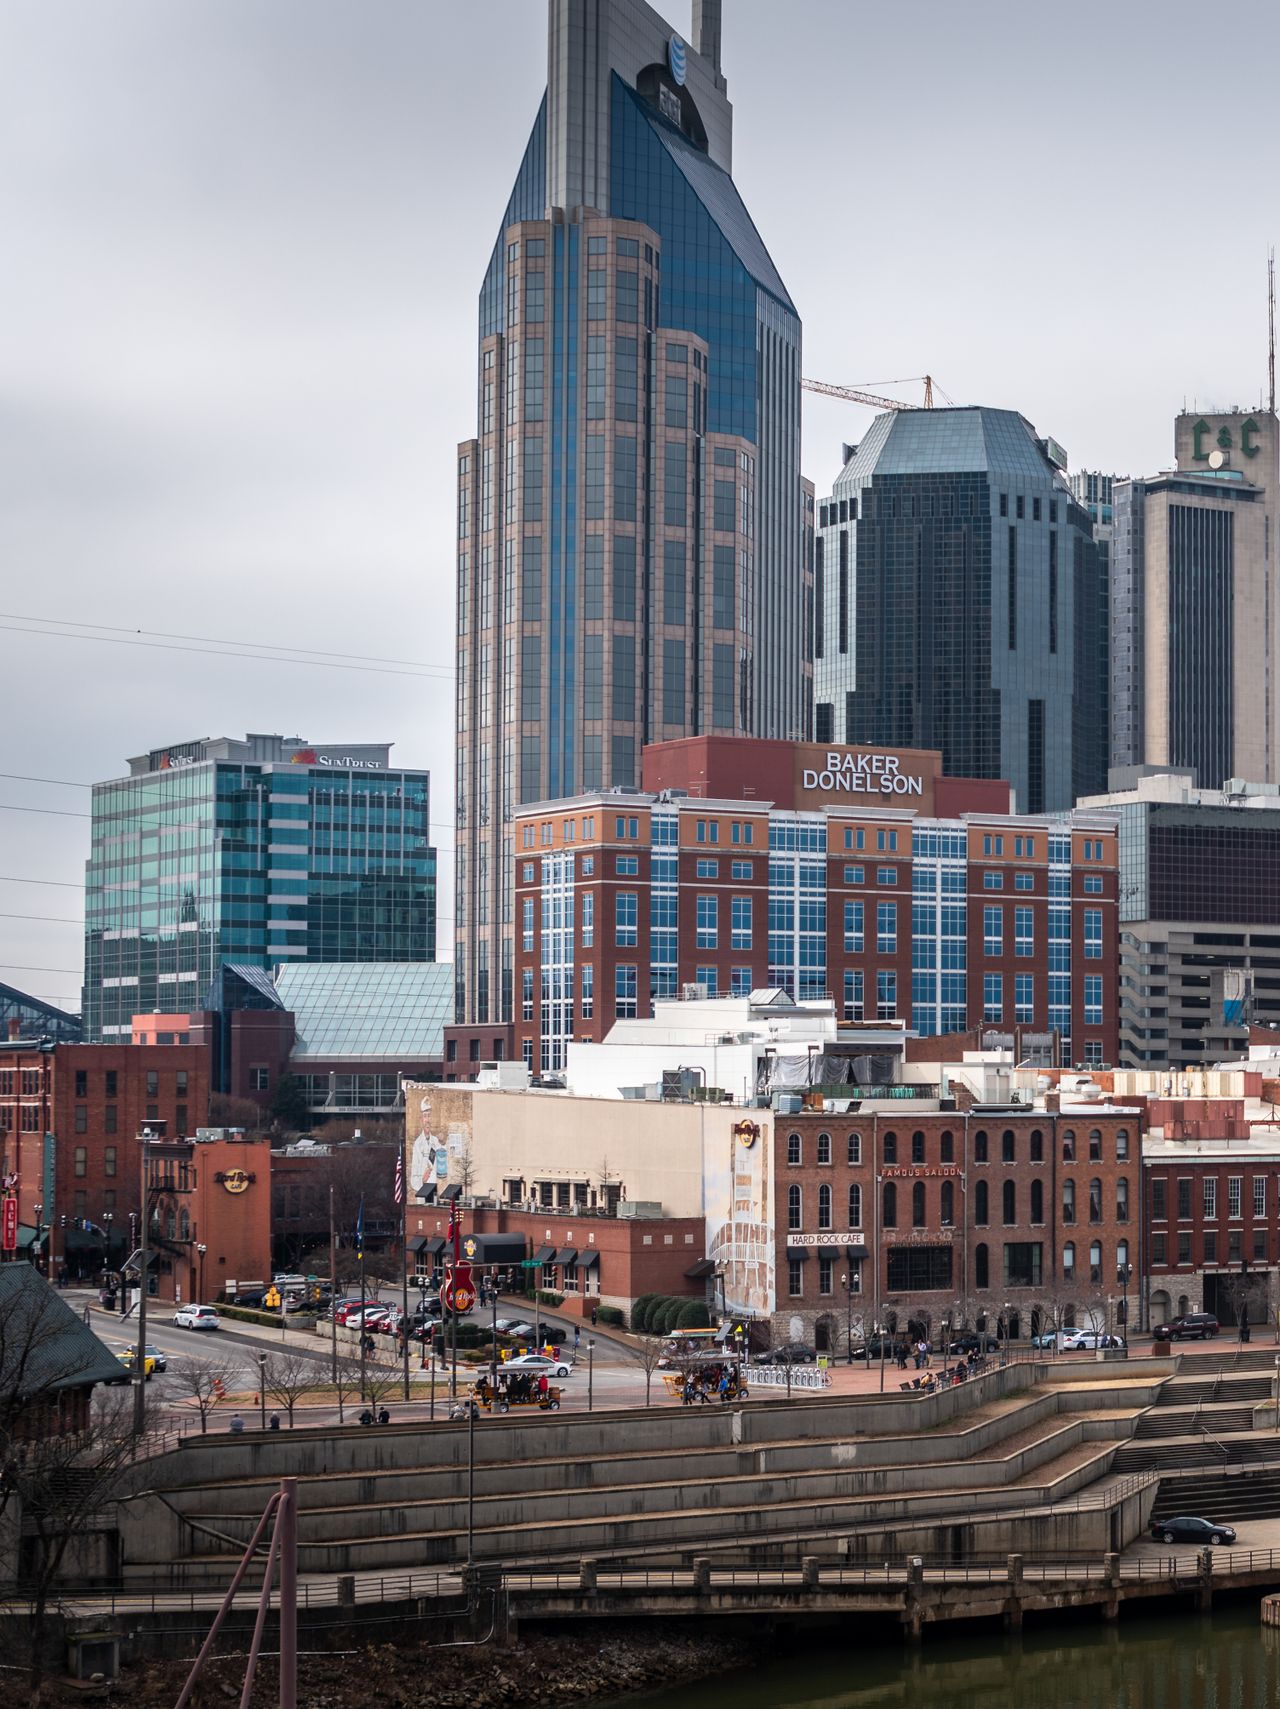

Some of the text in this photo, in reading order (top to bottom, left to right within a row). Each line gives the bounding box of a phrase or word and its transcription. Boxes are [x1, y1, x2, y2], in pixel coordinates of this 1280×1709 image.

[827, 752, 899, 775] BAKER
[803, 769, 923, 795] DONELSON
[881, 1168, 962, 1177] FAMOUS SALOON
[792, 1234, 862, 1245] HARD ROCK CAFE
